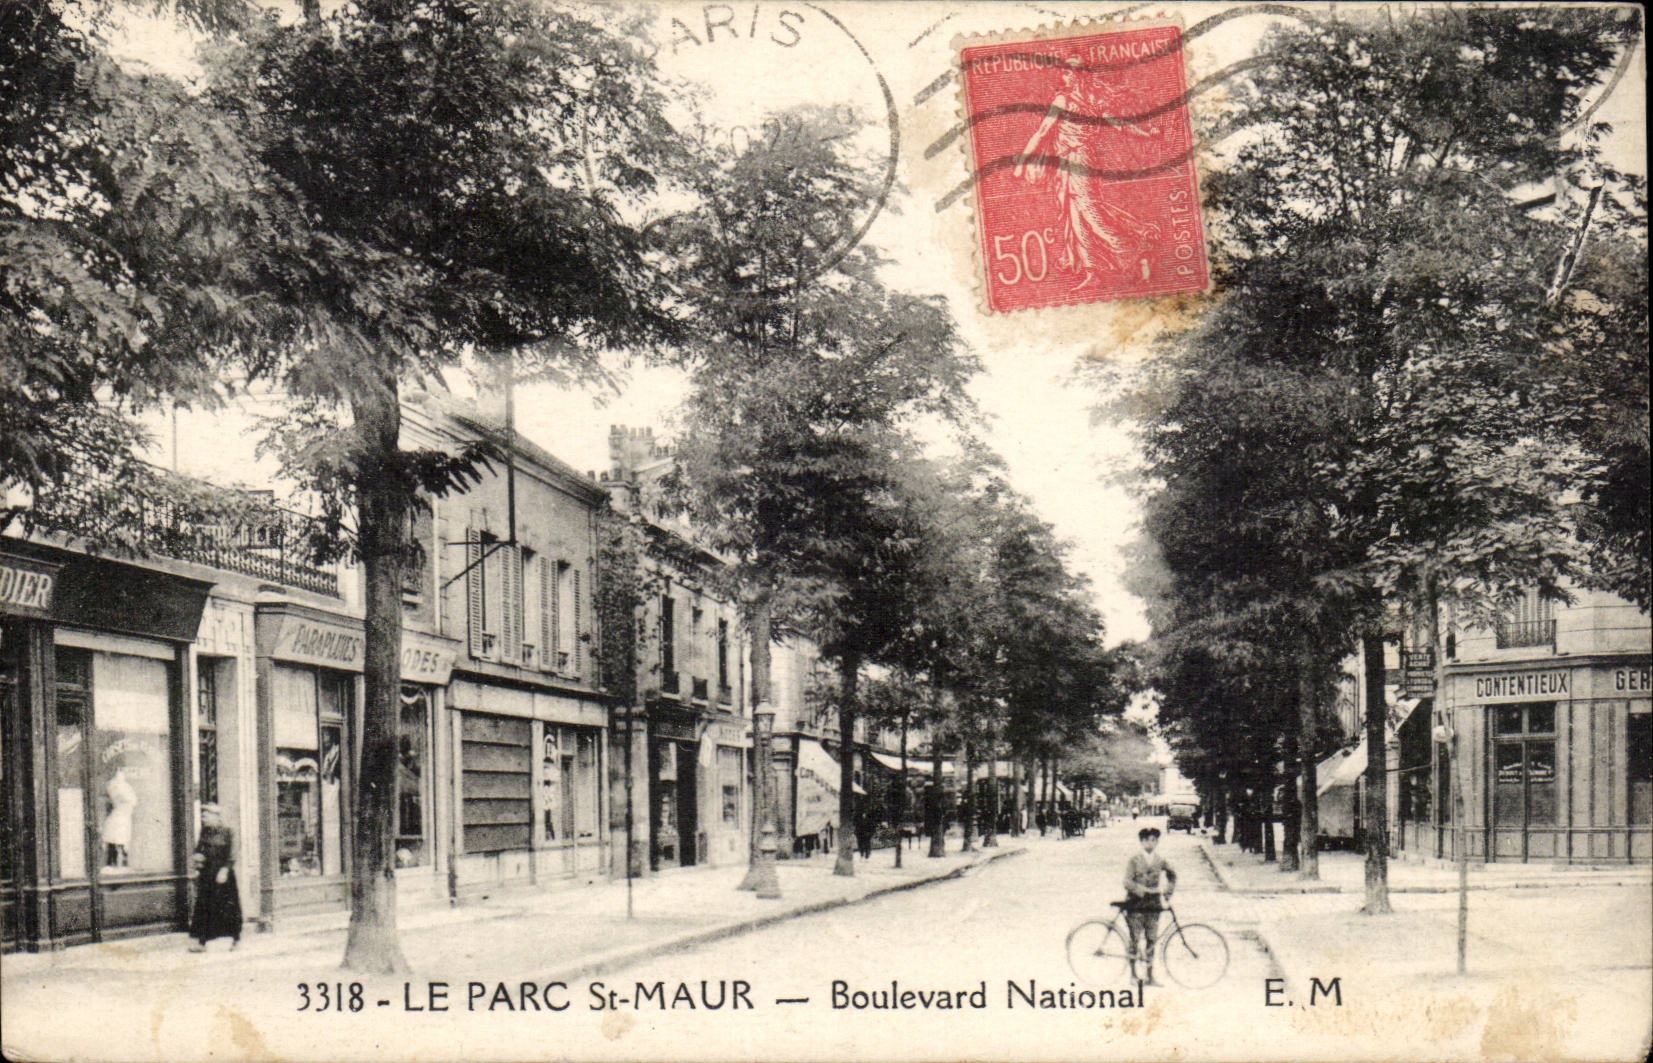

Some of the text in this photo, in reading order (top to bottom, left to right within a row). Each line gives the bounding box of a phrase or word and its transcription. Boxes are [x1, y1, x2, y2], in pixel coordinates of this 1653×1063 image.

[1168, 189, 1195, 277] POSTES
[402, 648, 440, 673] ODES
[1476, 672, 1568, 698] CONTENTIEUX
